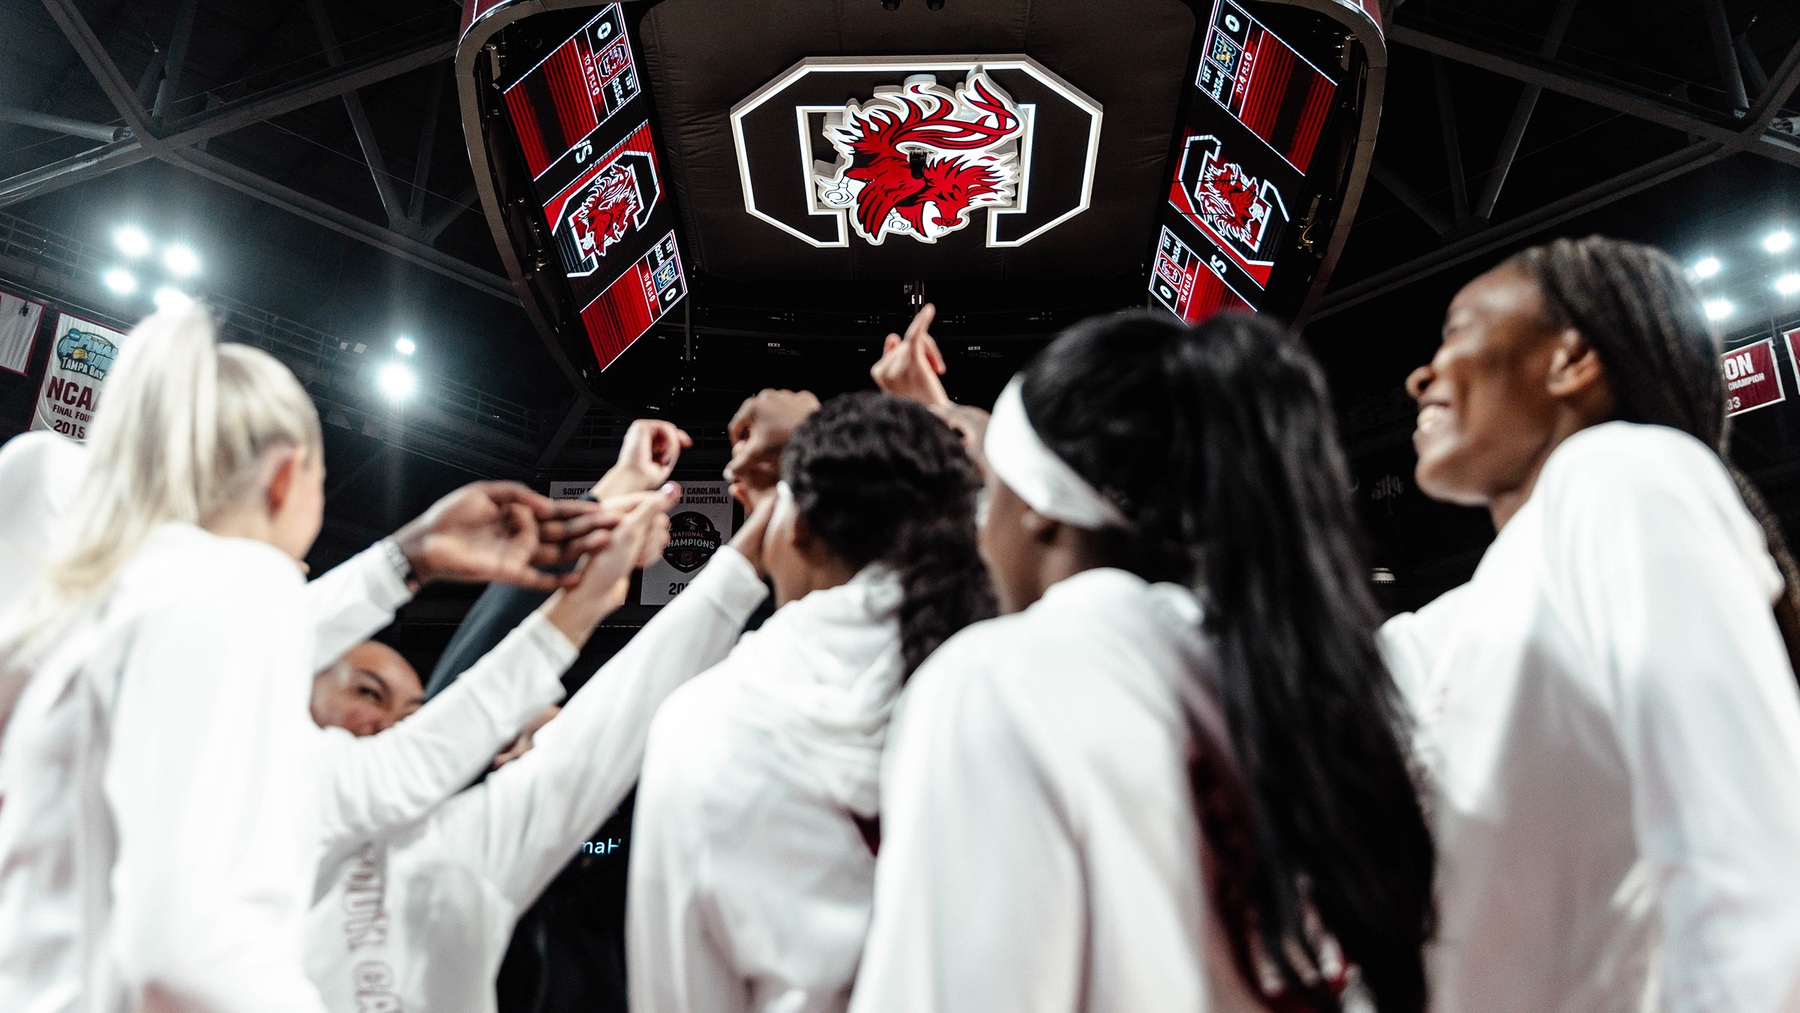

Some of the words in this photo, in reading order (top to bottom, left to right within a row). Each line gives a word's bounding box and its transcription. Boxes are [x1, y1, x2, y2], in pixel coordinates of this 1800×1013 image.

[597, 22, 611, 39] 0
[1225, 14, 1240, 32] 0
[625, 72, 634, 90] 1ST
[1202, 65, 1212, 83] 1ST
[1239, 75, 1247, 84] 4
[1236, 83, 1244, 94] TO
[664, 287, 677, 302] 0
[1159, 285, 1172, 300] 0
[61, 356, 88, 374] TAMPA
[89, 365, 105, 380] BAY
[1720, 352, 1754, 380] ON
[52, 404, 73, 418] FINAL
[53, 419, 85, 439] 2015
[562, 487, 585, 495] SOUTH
[686, 487, 721, 495] CAROLINA
[686, 496, 729, 504] BASKETBALL
[663, 538, 715, 550] HAMPIONS
[668, 582, 691, 596] 20
